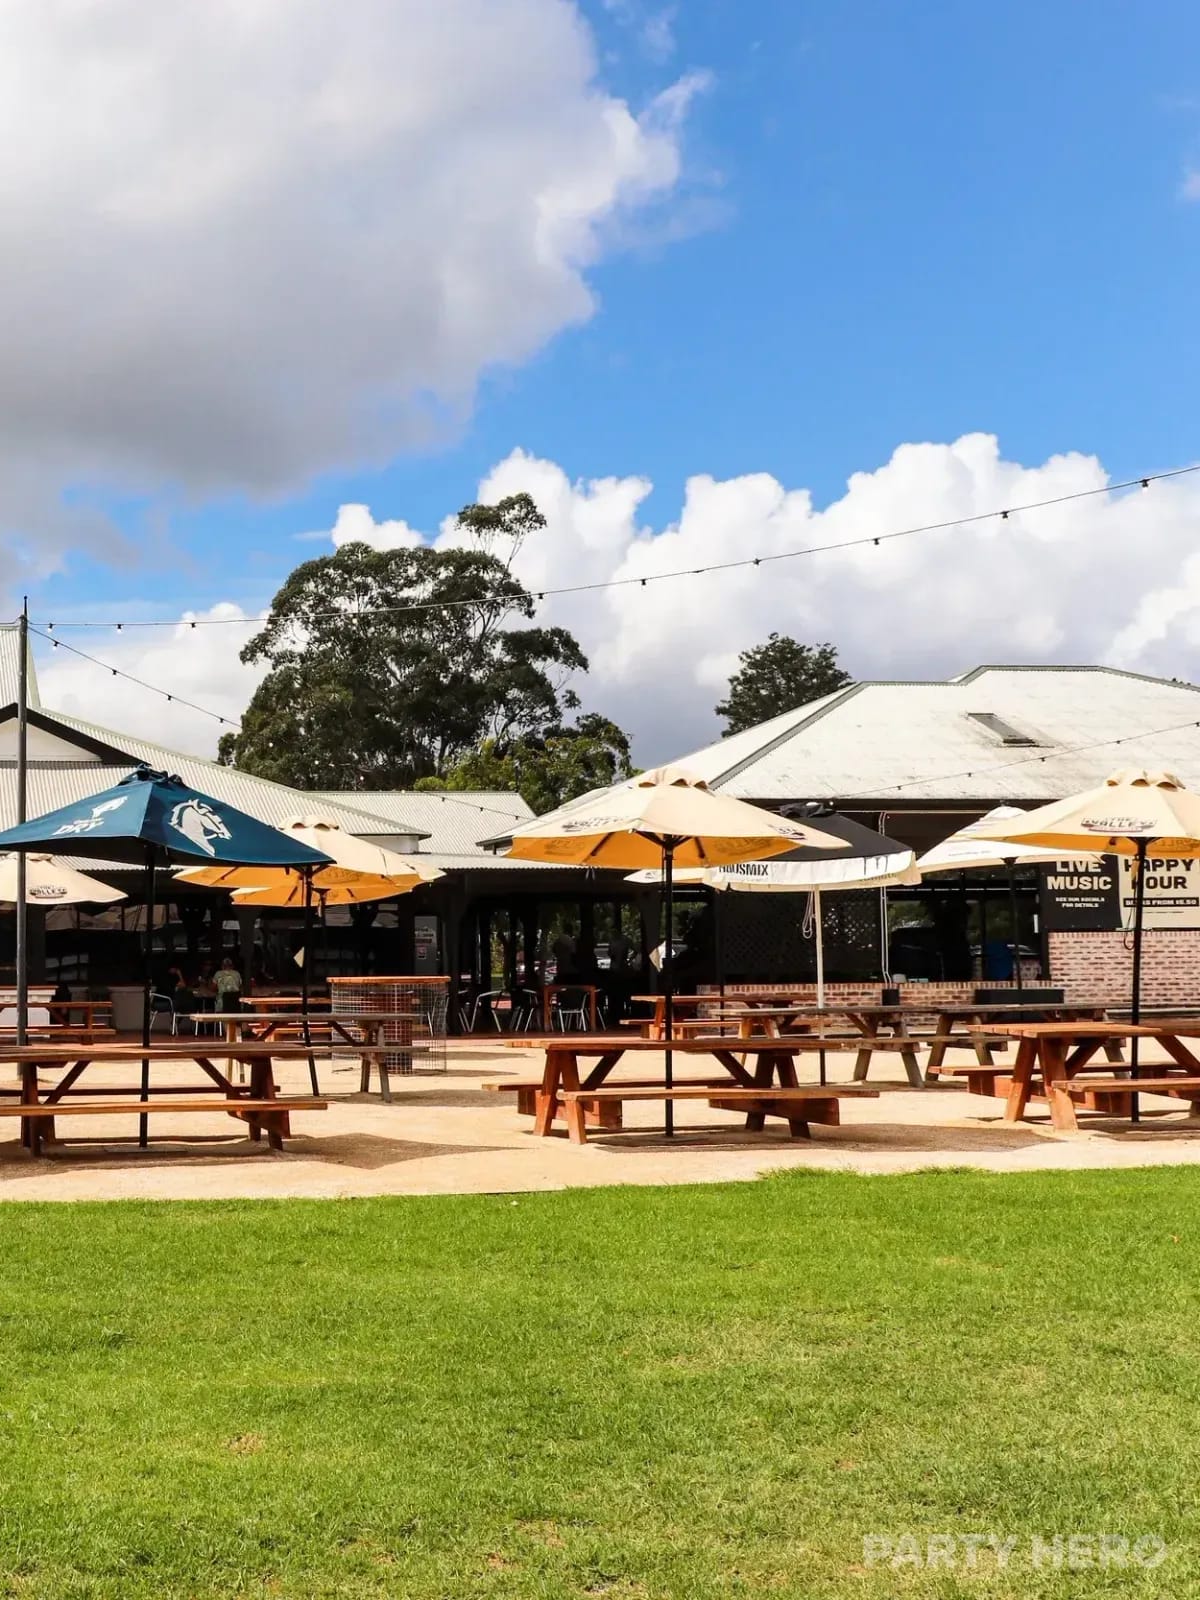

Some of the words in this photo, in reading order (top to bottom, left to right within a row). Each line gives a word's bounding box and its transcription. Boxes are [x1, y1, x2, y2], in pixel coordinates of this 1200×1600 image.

[51, 821, 105, 836] DRY
[1056, 860, 1102, 873] LIVE
[1047, 876, 1113, 890] MUSIC
